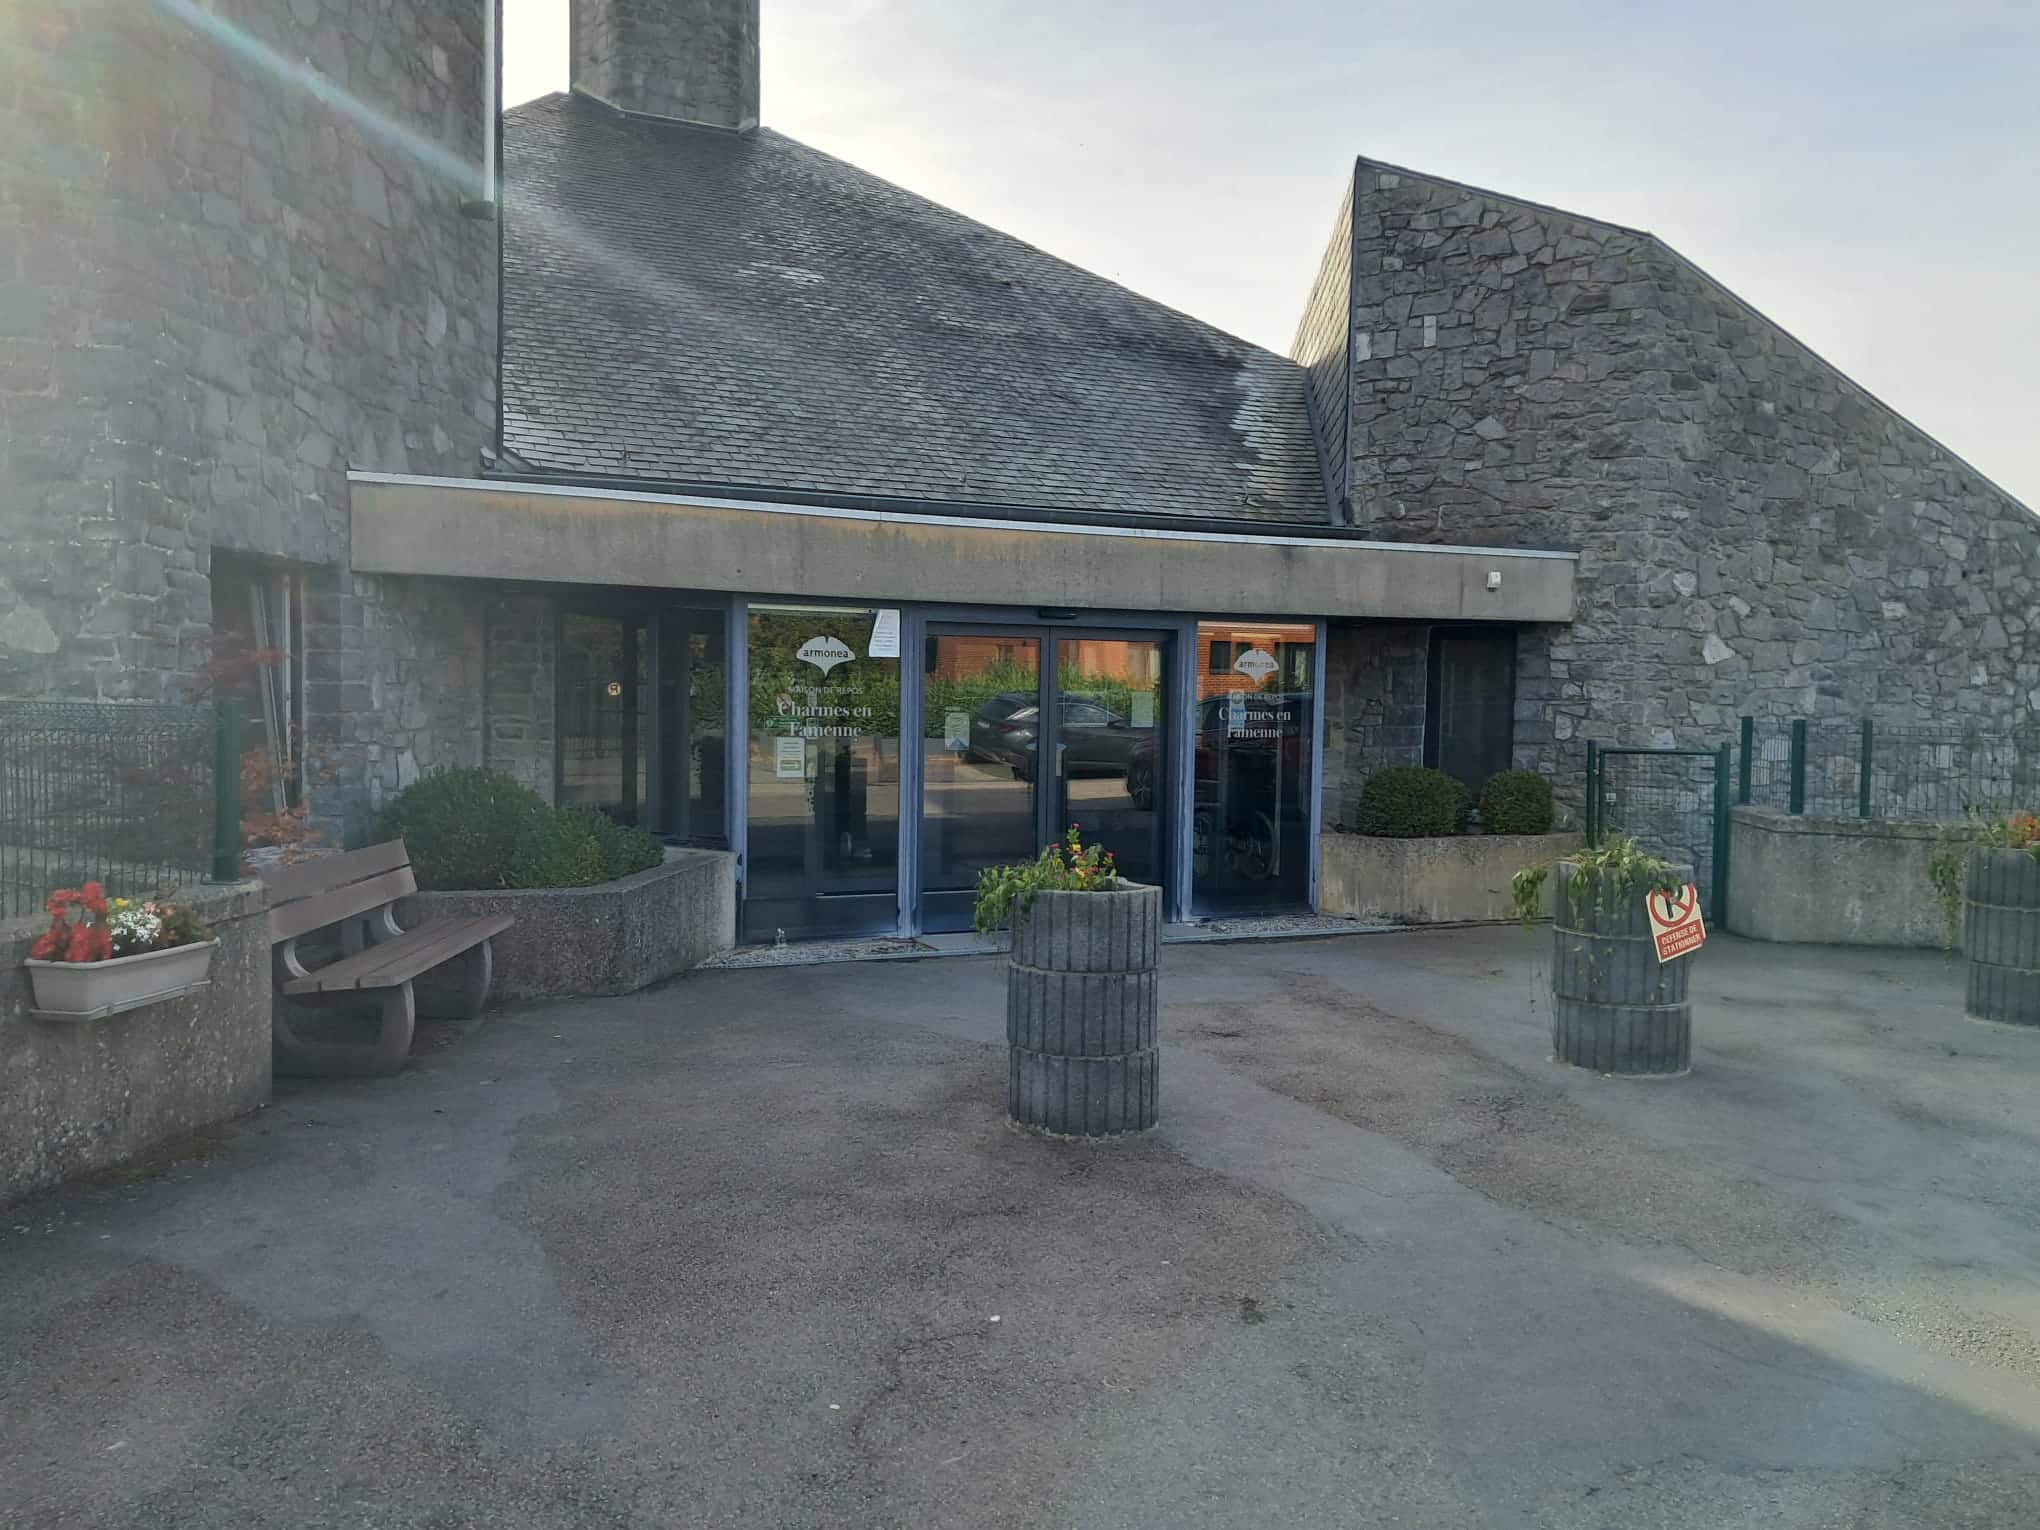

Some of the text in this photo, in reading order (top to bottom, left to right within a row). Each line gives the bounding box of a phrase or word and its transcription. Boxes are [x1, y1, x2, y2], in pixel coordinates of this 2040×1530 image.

[803, 649, 849, 658] armonea
[1239, 661, 1275, 670] armea
[778, 701, 872, 717] Charmes en
[1218, 707, 1292, 721] Charmes en
